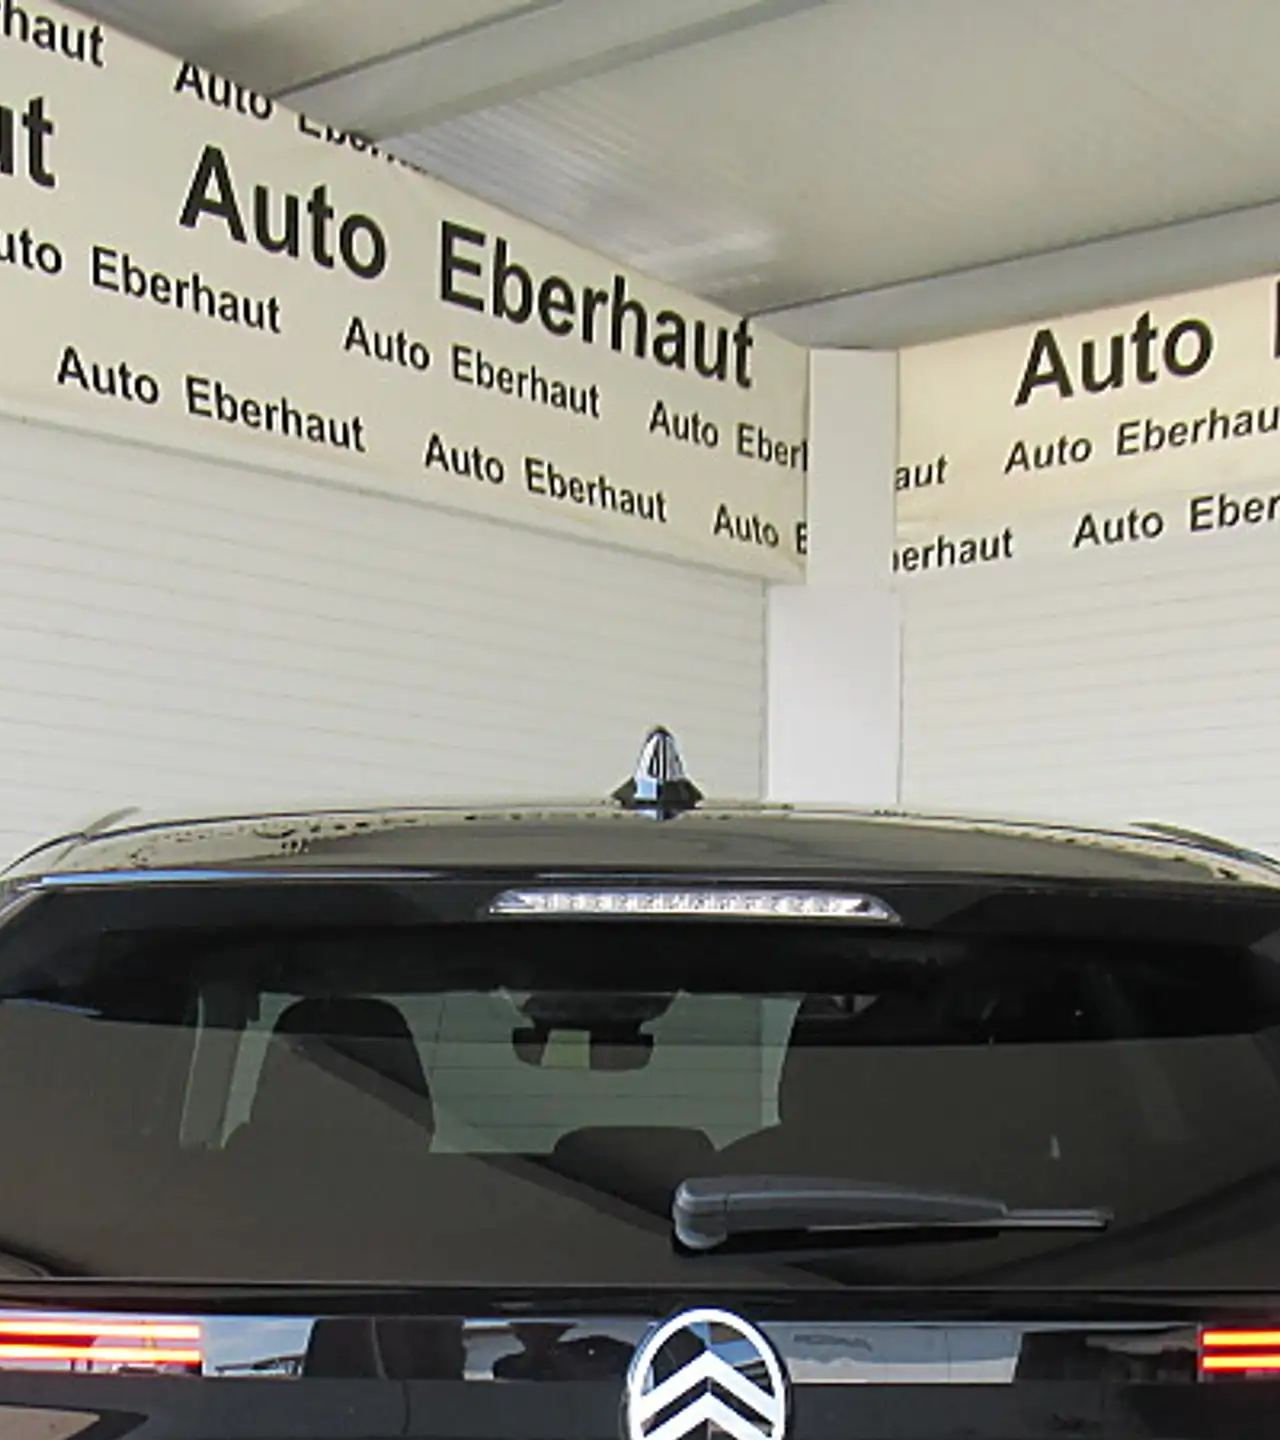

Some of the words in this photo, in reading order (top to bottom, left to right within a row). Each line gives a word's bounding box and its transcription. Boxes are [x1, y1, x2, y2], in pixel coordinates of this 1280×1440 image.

[180, 145, 386, 279] Auto
[441, 221, 754, 389] Eberhaut
[93, 246, 280, 334] Eberhaut
[344, 316, 429, 370] Auto
[452, 344, 599, 418] Eberhaut
[650, 400, 718, 448] Auto
[1015, 312, 1212, 406] Auto
[58, 346, 158, 404] Auto
[186, 375, 365, 452] Eberhaut
[425, 433, 503, 484] Auto
[525, 457, 666, 523] Eberhaut
[713, 504, 779, 548] Auto
[1004, 435, 1092, 475] Auto
[1073, 509, 1163, 548] Auto
